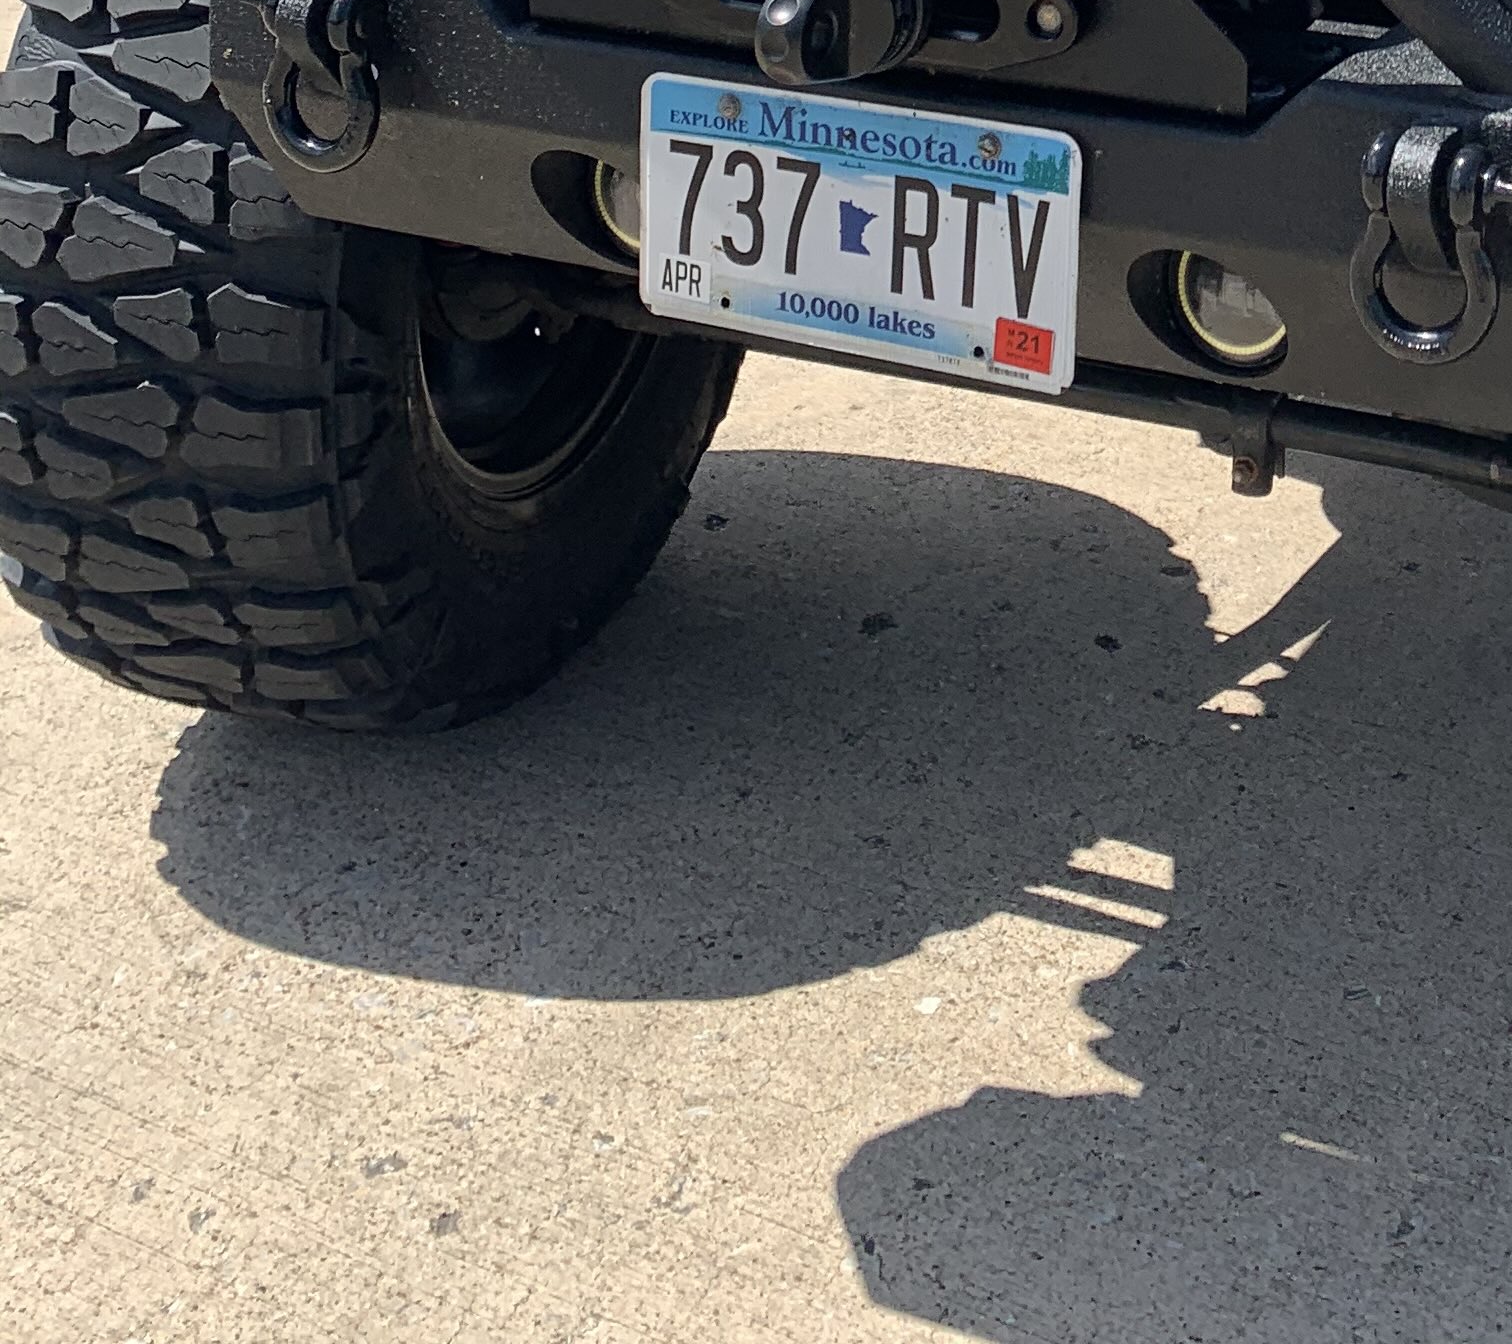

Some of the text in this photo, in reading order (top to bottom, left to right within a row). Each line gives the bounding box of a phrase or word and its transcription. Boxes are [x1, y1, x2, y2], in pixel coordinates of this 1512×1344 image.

[669, 108, 749, 135] EXPLORE
[669, 138, 1051, 319] 737 RTV
[660, 258, 702, 298] APR
[775, 290, 936, 340] 10,000 lakes
[1015, 331, 1040, 354] 21
